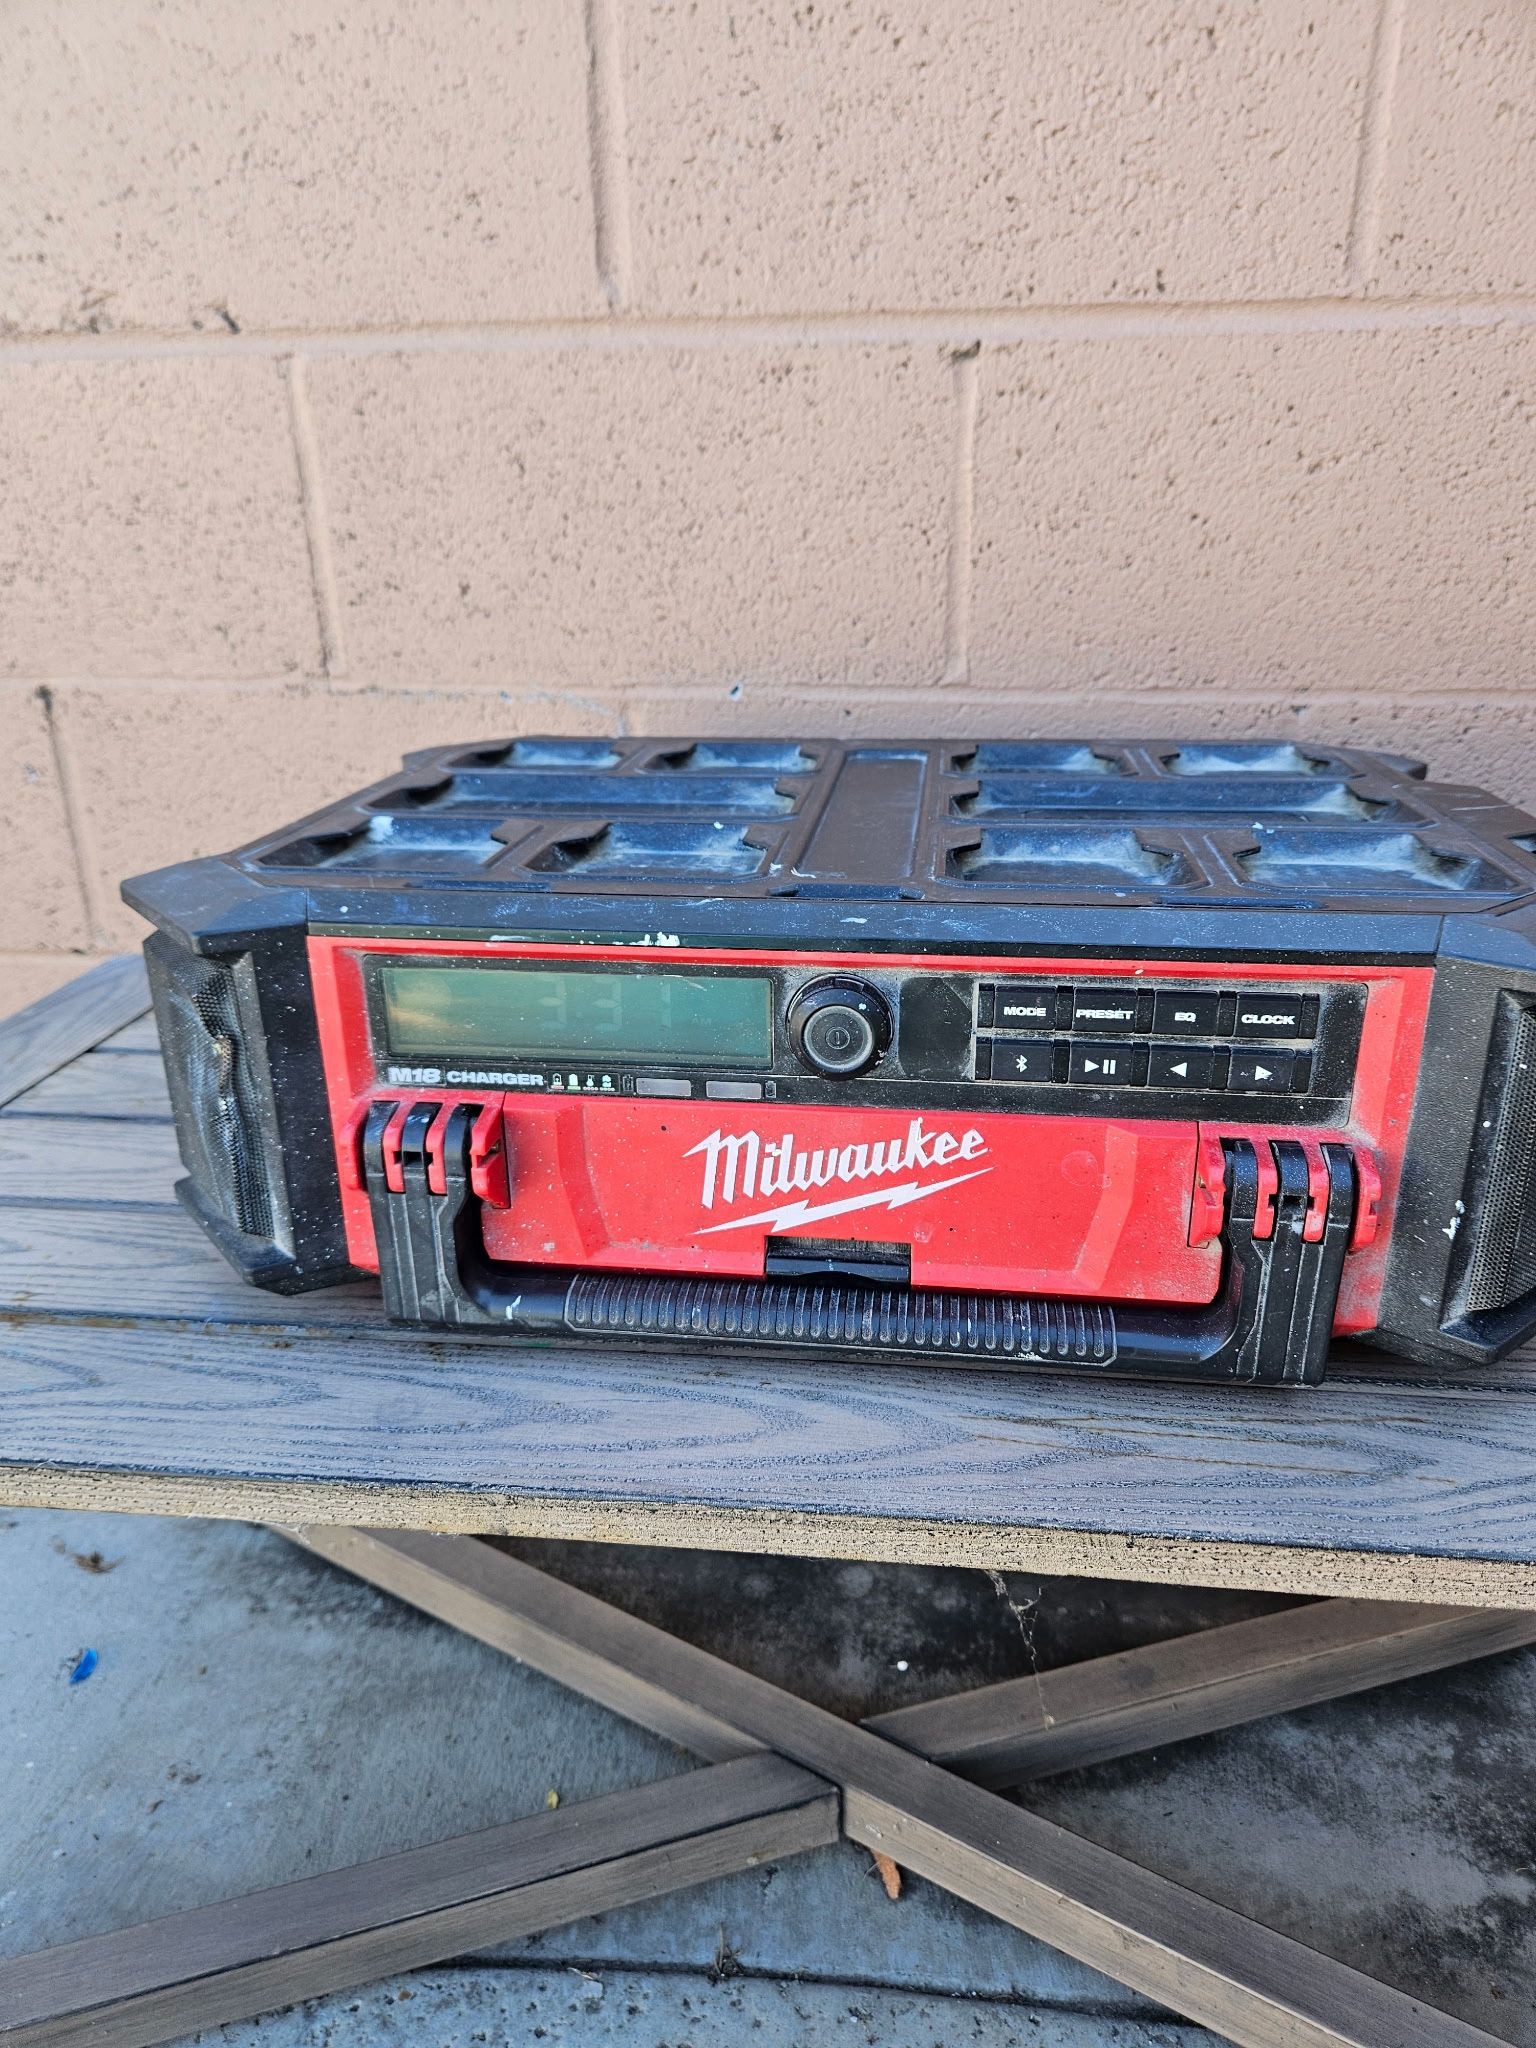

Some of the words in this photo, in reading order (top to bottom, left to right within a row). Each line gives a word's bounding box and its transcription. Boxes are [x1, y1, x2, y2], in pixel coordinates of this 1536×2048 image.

[1003, 1006, 1047, 1016] MODE
[1075, 1008, 1133, 1020] PRESET
[1174, 1012, 1196, 1022] EQ
[1241, 1014, 1295, 1025] CLOCK
[388, 1066, 442, 1084] M18
[446, 1070, 544, 1086] CHARGER
[682, 1117, 989, 1209] Milwaukee
